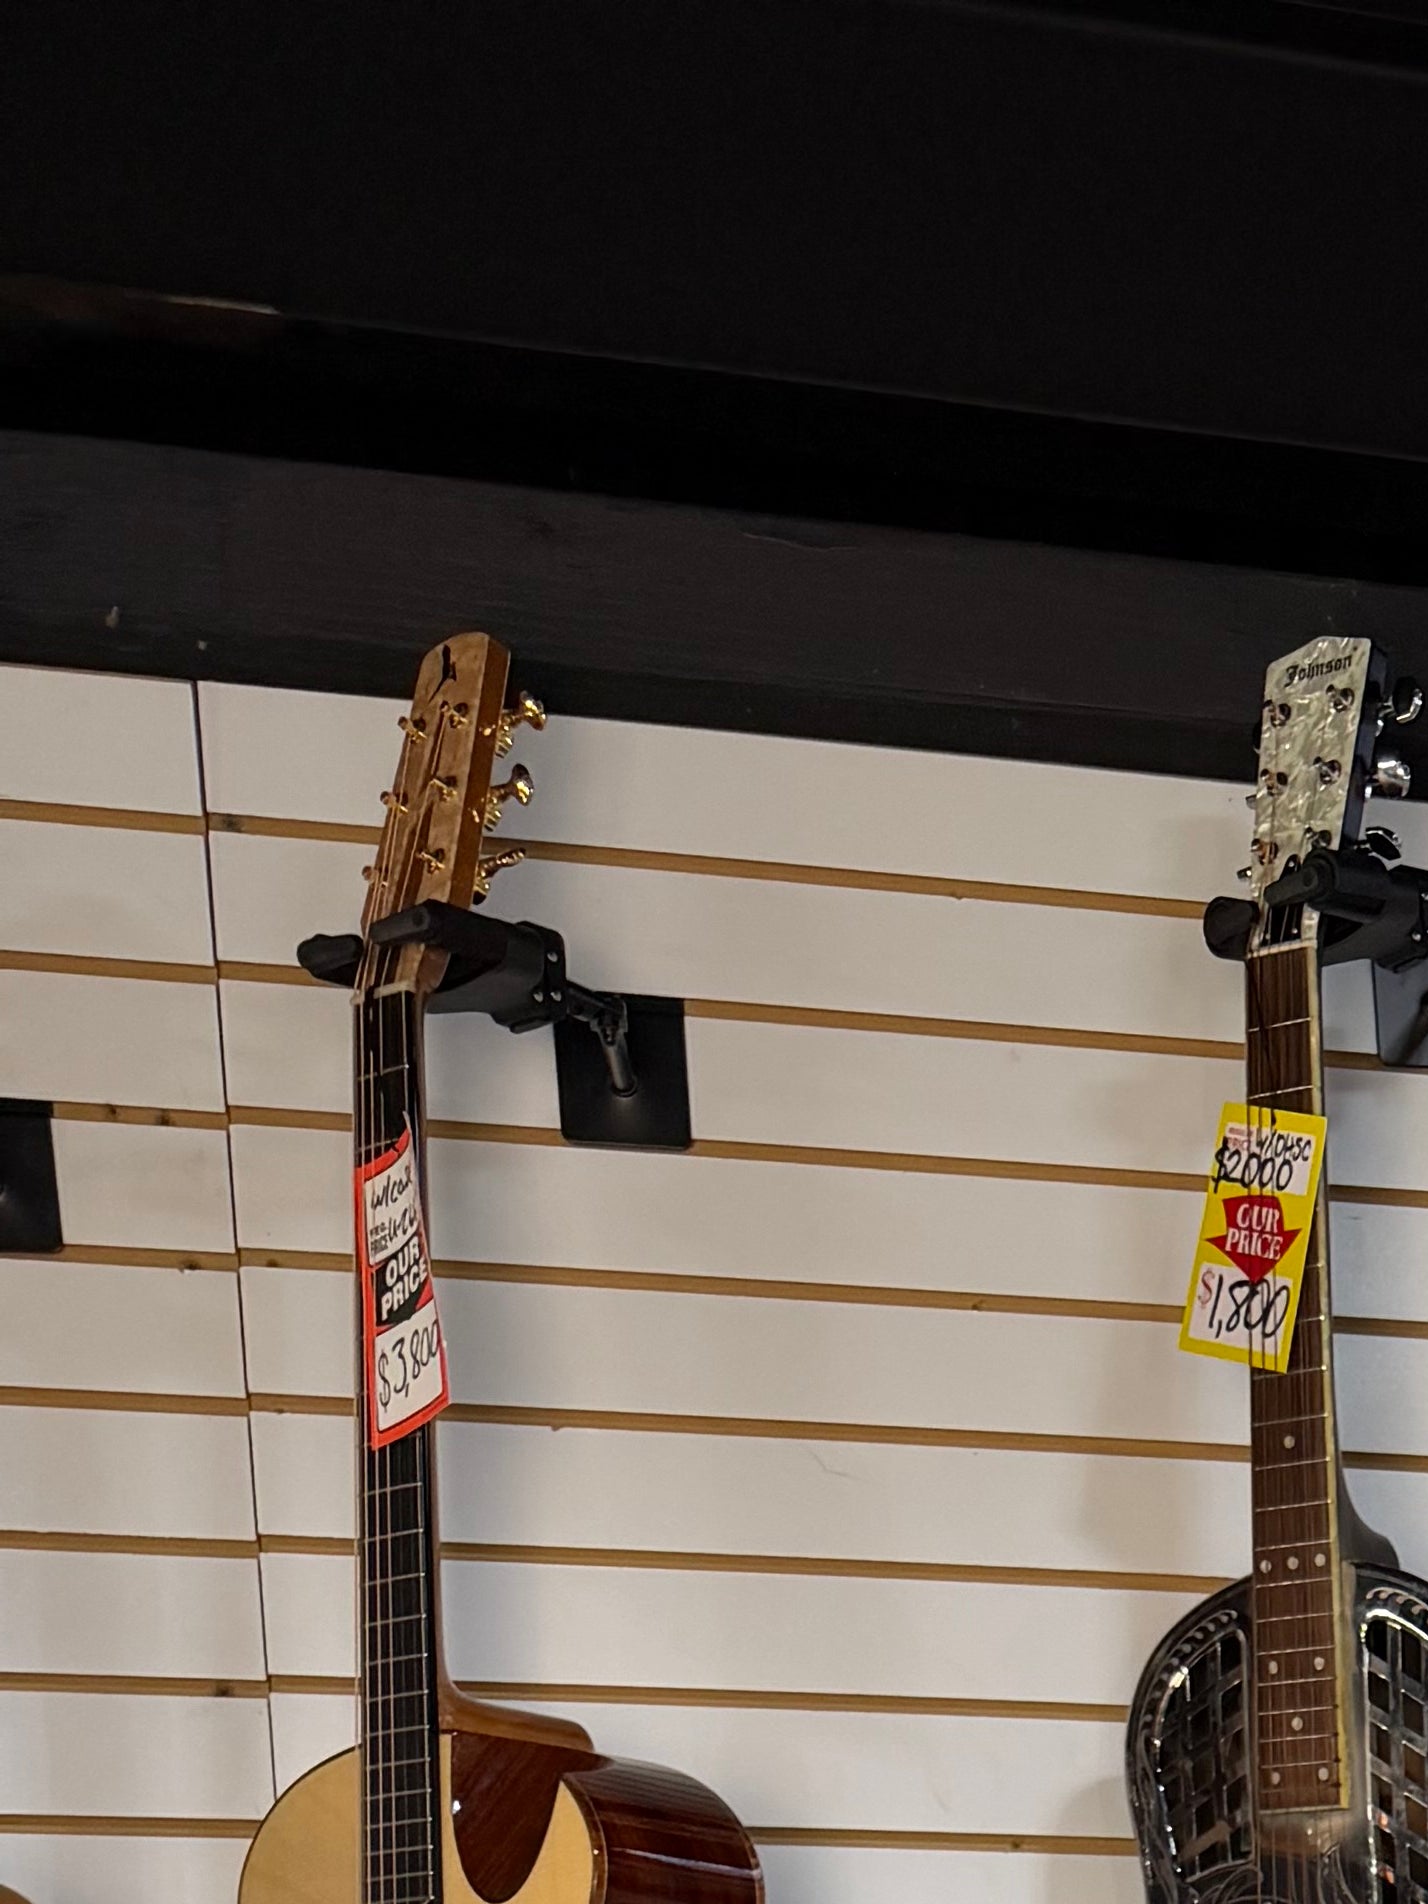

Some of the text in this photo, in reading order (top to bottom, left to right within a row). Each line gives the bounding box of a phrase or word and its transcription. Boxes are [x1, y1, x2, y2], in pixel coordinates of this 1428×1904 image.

[1284, 655, 1353, 688] Johnson
[1211, 1136, 1293, 1194] $2000
[1236, 1203, 1281, 1232] OUR
[384, 1239, 421, 1281] OUR
[1225, 1227, 1285, 1261] PRICE
[380, 1258, 429, 1322] PRICE
[378, 1319, 440, 1413] $3,800
